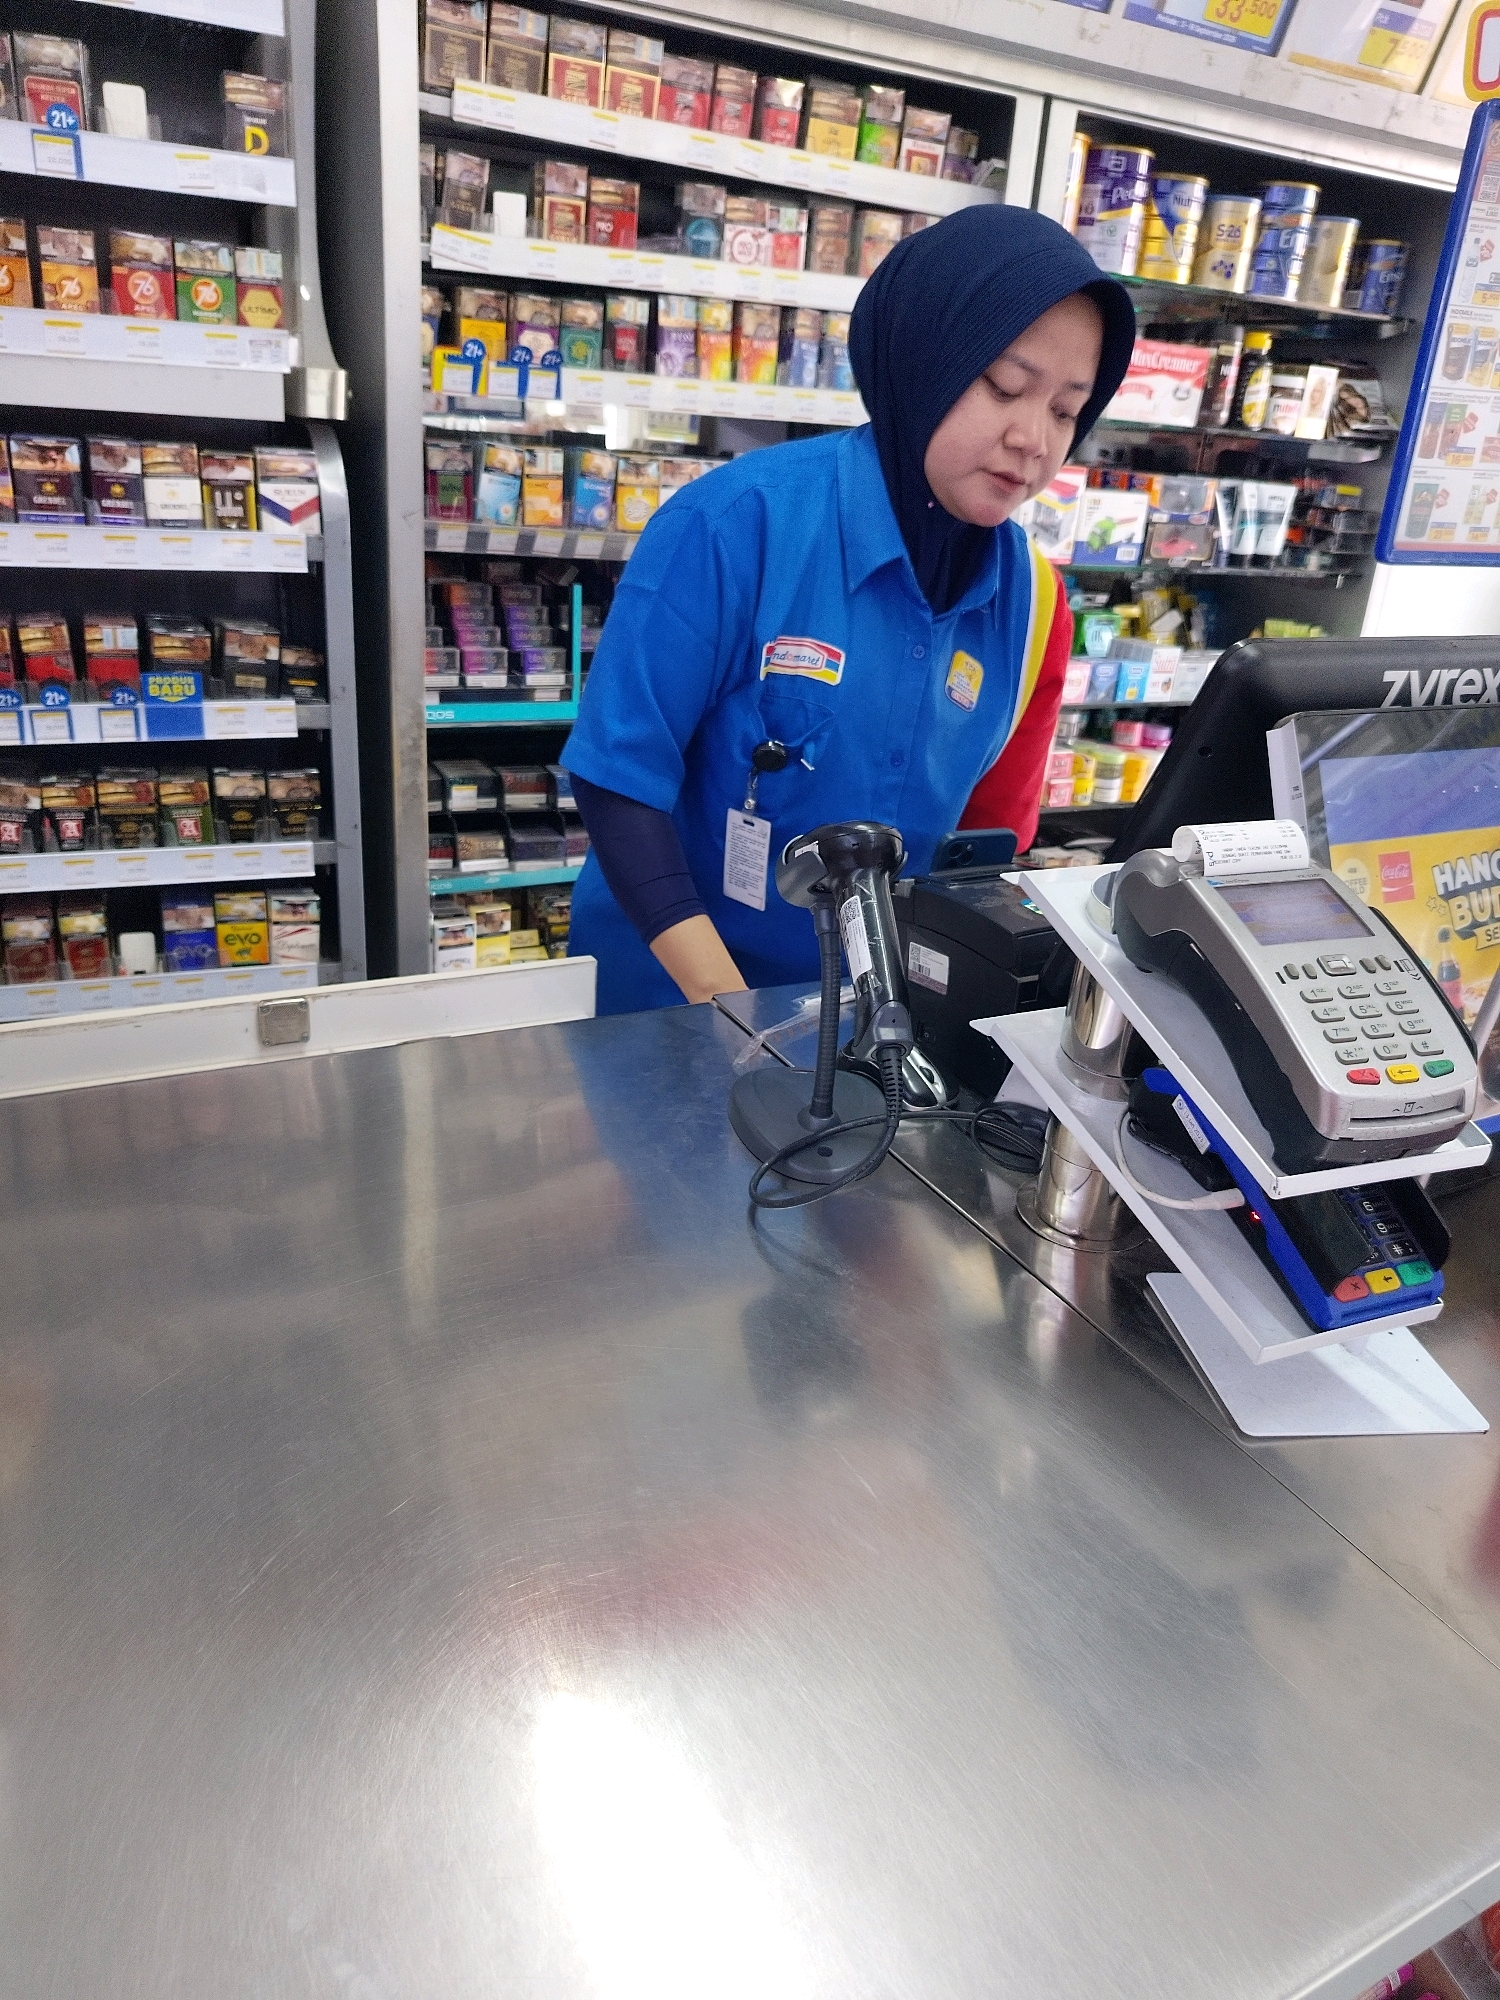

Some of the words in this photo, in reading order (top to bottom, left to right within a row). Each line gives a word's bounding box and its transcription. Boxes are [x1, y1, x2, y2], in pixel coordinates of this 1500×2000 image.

[51, 109, 77, 129] 21+
[61, 277, 82, 299] 76
[133, 275, 155, 299] 76
[770, 650, 821, 667] ndomaret
[149, 684, 196, 697] BARU
[1380, 667, 1500, 708] zyrex
[45, 690, 68, 706] 21+
[115, 692, 137, 705] 21+
[1346, 877, 1368, 887] OFFEE
[224, 933, 262, 946] evo
[1346, 985, 1355, 994] 2
[1383, 982, 1391, 990] 3
[1310, 989, 1318, 998] 1
[1359, 1005, 1367, 1014] 5
[1395, 1001, 1403, 1009] 6
[1322, 1008, 1330, 1017] 4
[1370, 1024, 1379, 1034] 8
[1406, 1020, 1415, 1029] 9
[1332, 1028, 1339, 1037] 7
[1383, 1045, 1390, 1054] 0
[1362, 1201, 1374, 1212] 6
[1376, 1222, 1388, 1234] 9
